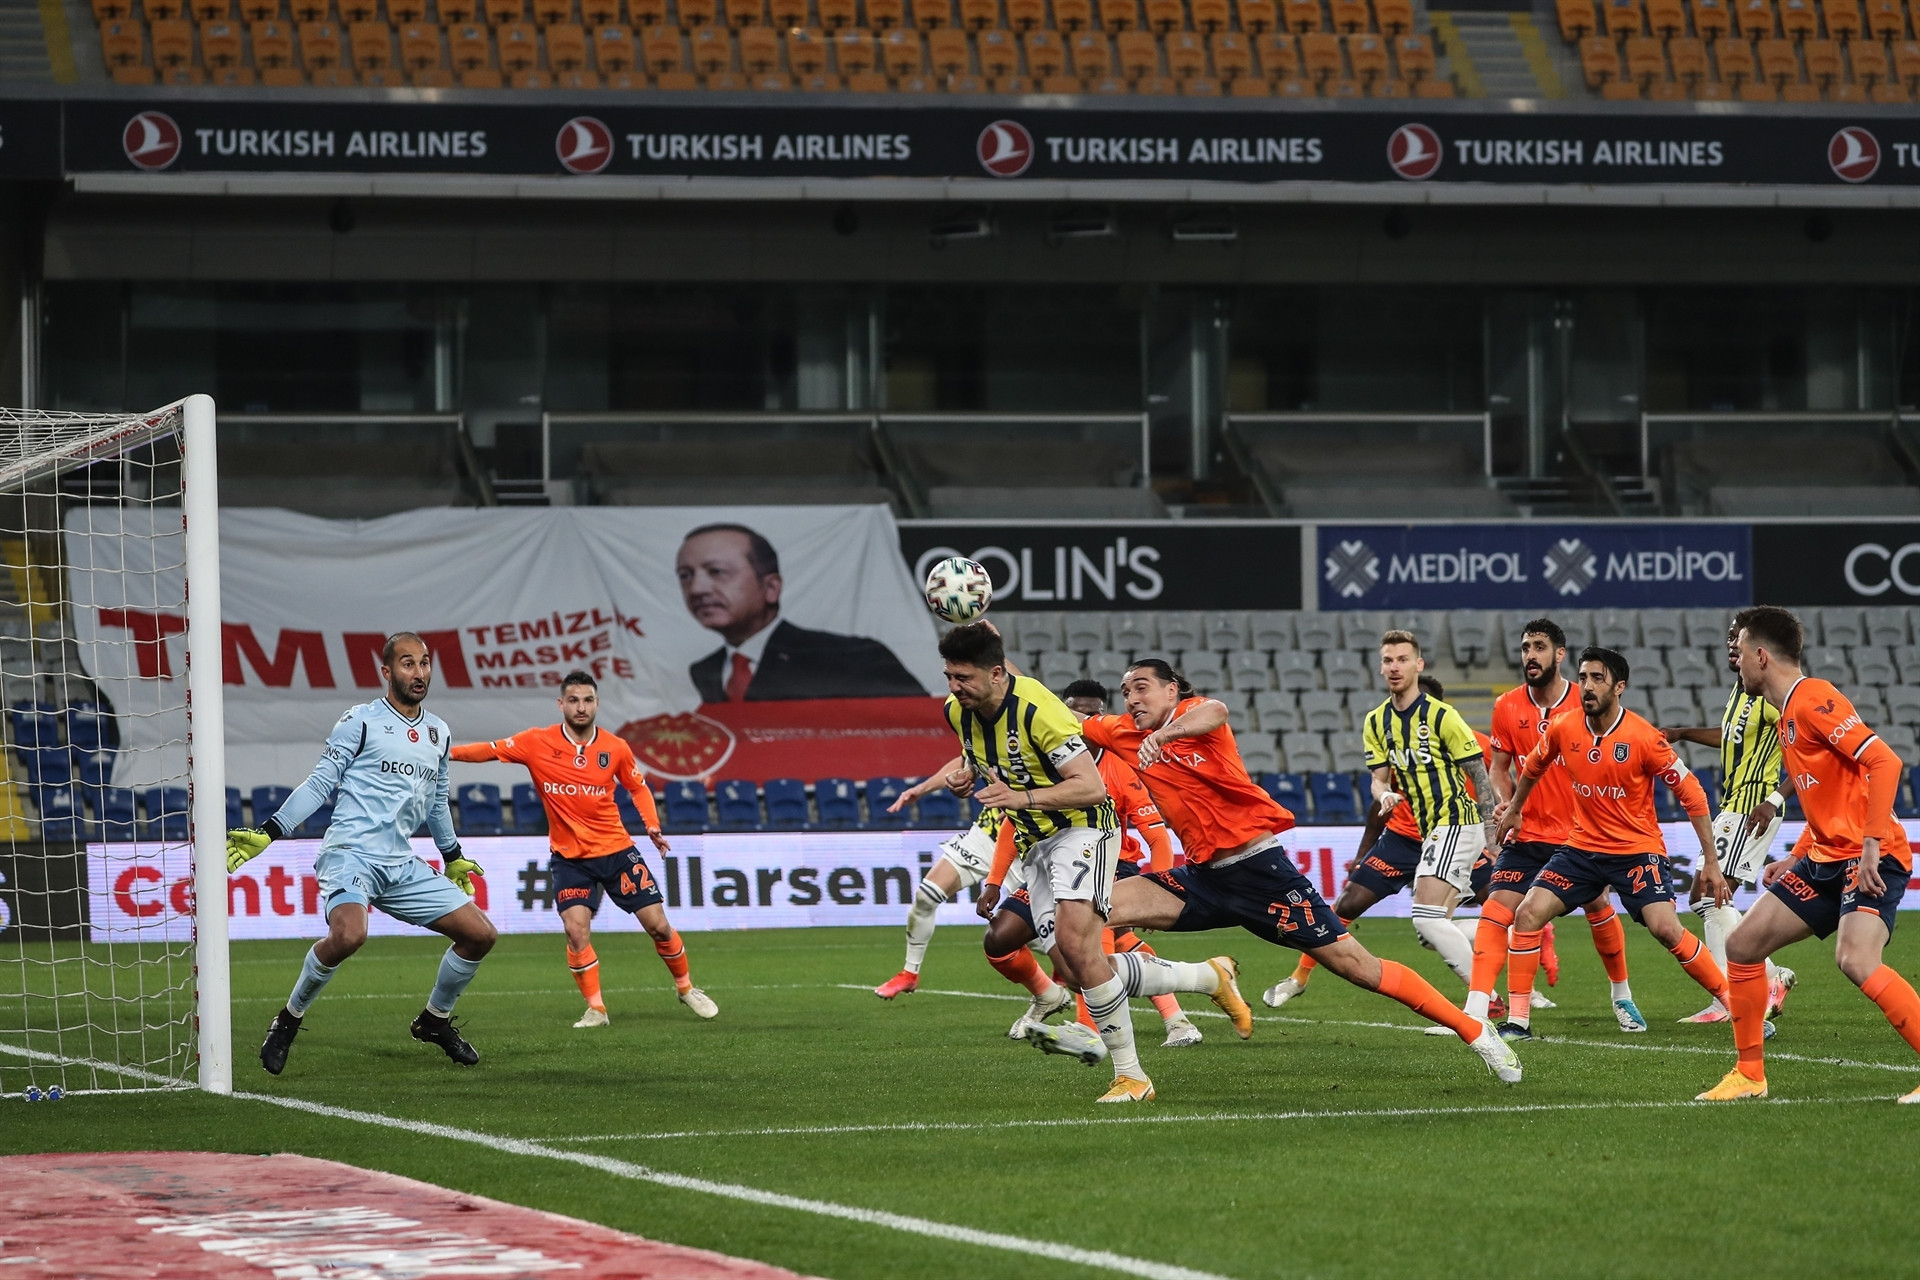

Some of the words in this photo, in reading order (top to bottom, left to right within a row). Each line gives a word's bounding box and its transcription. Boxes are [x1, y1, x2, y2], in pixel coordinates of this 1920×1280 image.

[195, 129, 334, 156] TURKISH
[346, 131, 487, 157] AIRLINES
[627, 134, 762, 160] TURKISH
[773, 134, 910, 160] AIRLINES
[1046, 137, 1178, 163] TURKISH
[1188, 137, 1323, 163] AIRLINES
[1454, 139, 1583, 165] TURKISH
[1593, 140, 1723, 166] AIRLINES
[474, 631, 612, 669] MASKE
[481, 657, 635, 689] MESFE
[381, 760, 415, 776] DECO
[1388, 747, 1433, 768] AVIS
[543, 781, 577, 796] DECO
[1596, 785, 1627, 800] VITA
[1422, 843, 1437, 867] 4
[620, 863, 655, 896] 42
[1071, 859, 1091, 891] 7
